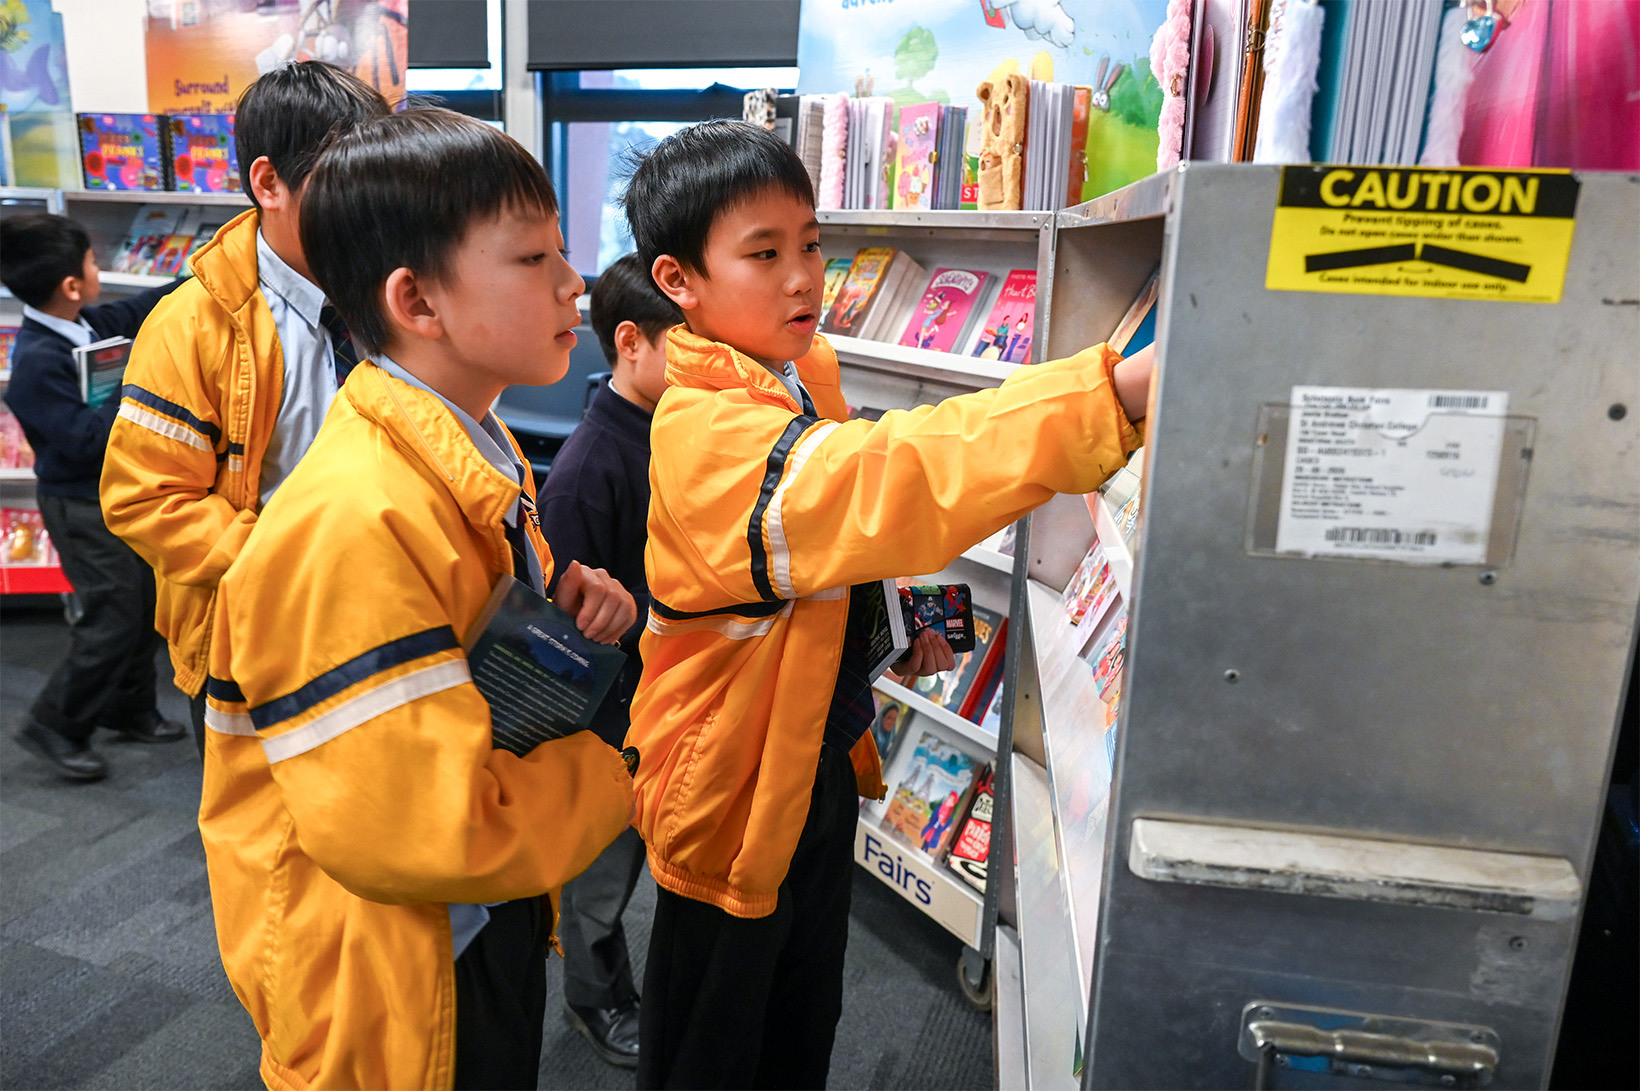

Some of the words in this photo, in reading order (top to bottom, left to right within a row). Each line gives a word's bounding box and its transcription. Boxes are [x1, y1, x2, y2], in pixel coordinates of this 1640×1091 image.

[174, 75, 229, 97] Surround
[1319, 169, 1540, 214] CAUTION
[1343, 213, 1393, 224] Prevent
[1395, 216, 1443, 229] tipping
[1447, 216, 1463, 227] of
[1319, 226, 1335, 236] Do
[1338, 227, 1356, 237] not
[1359, 229, 1386, 239] open
[1455, 232, 1480, 242] than
[1318, 273, 1350, 284] Cases
[1352, 276, 1401, 287] intended
[1403, 276, 1419, 288] for
[1422, 278, 1458, 289] indoor
[864, 833, 932, 905] Fairs
